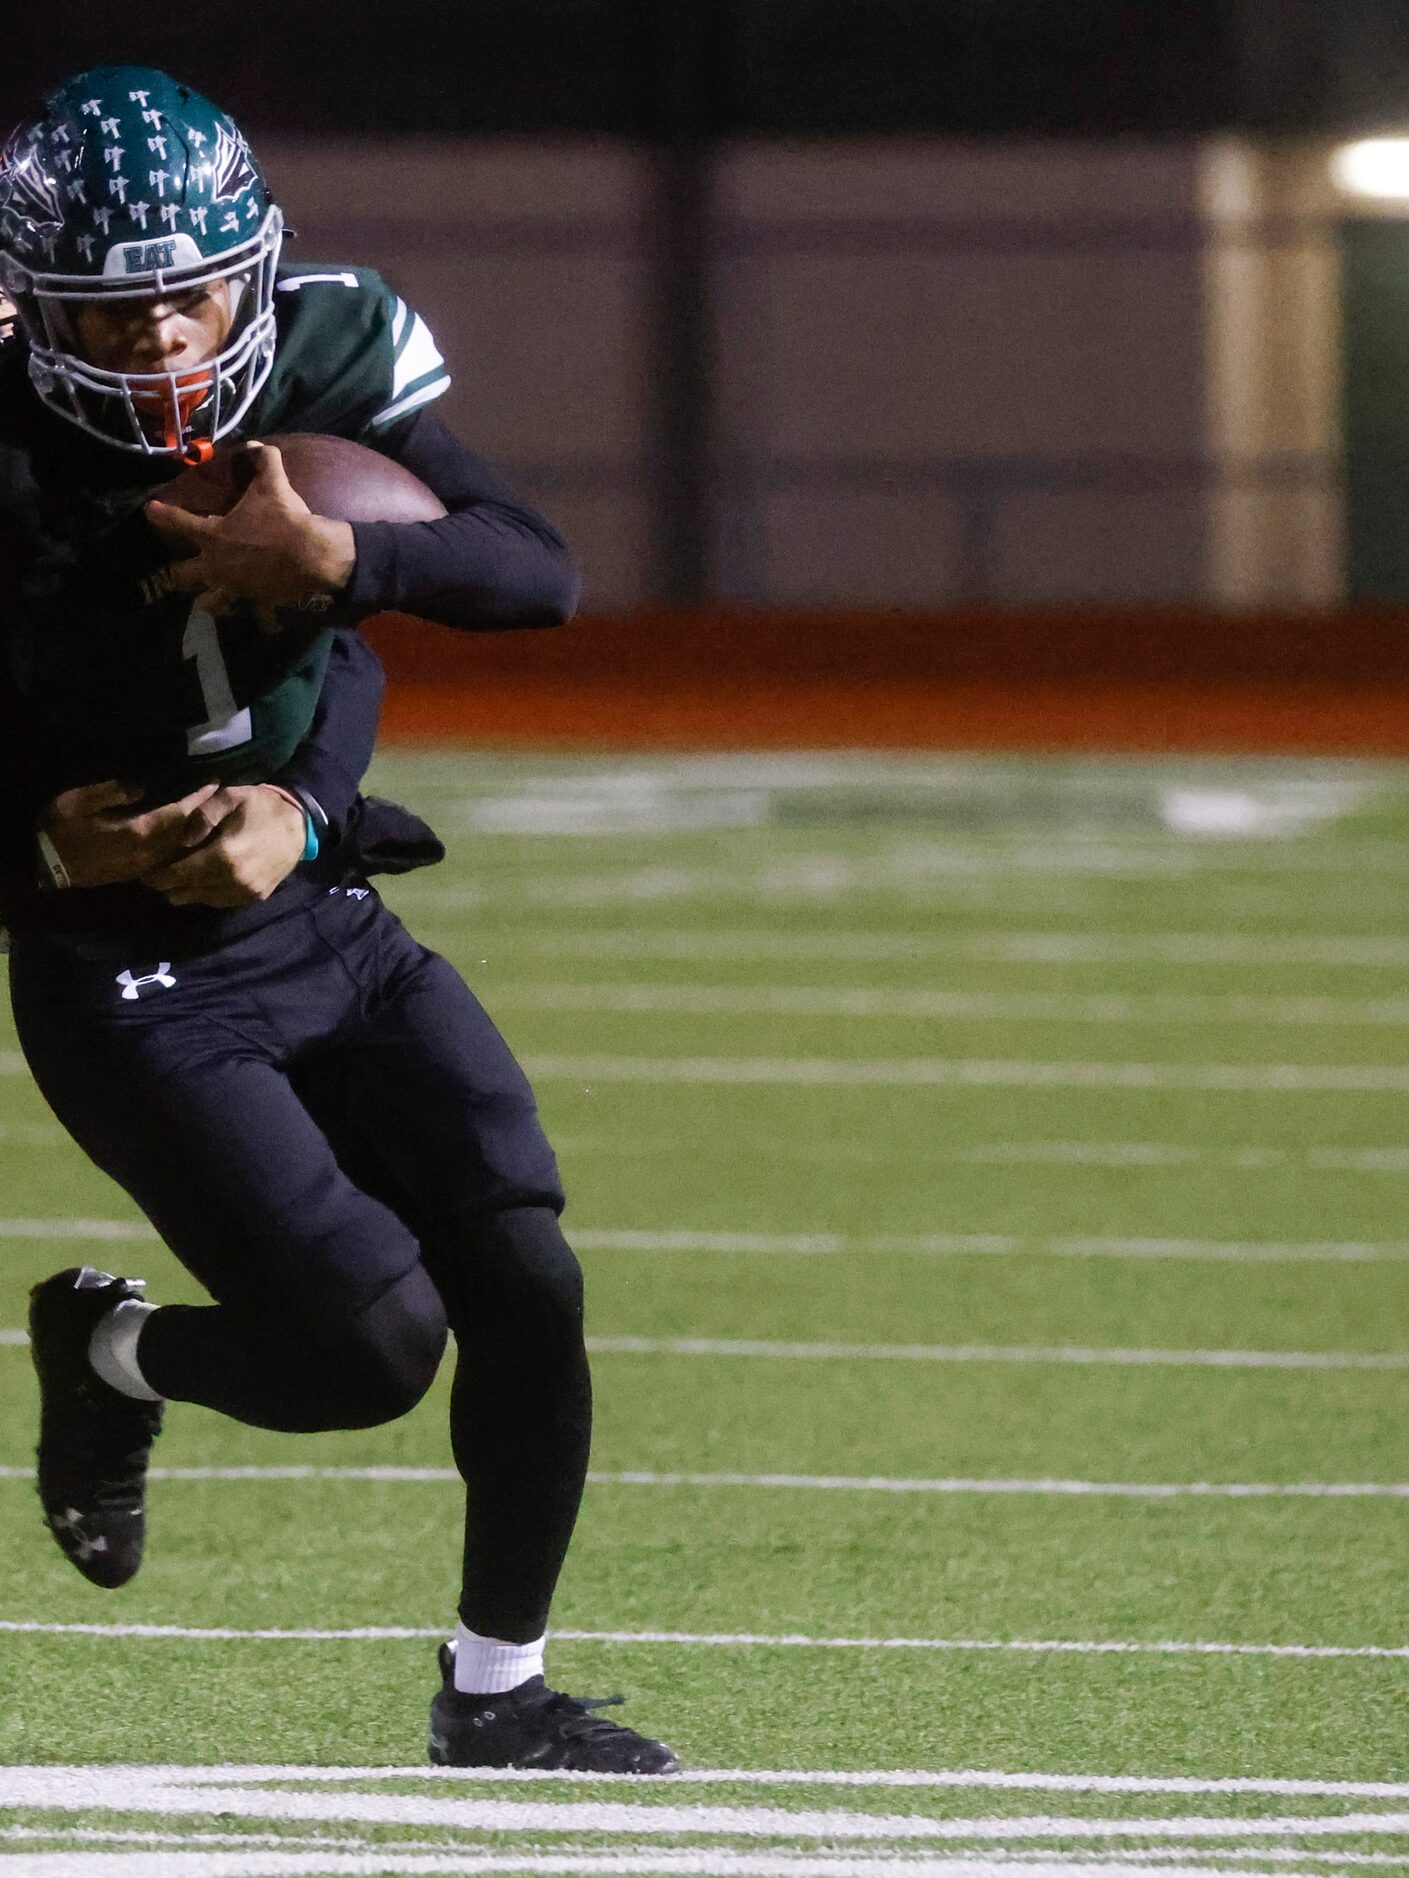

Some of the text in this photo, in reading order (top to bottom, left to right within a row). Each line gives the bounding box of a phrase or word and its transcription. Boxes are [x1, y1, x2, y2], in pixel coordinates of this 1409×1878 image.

[123, 239, 177, 274] EAT
[276, 272, 359, 291] 1
[182, 603, 252, 756] 1
